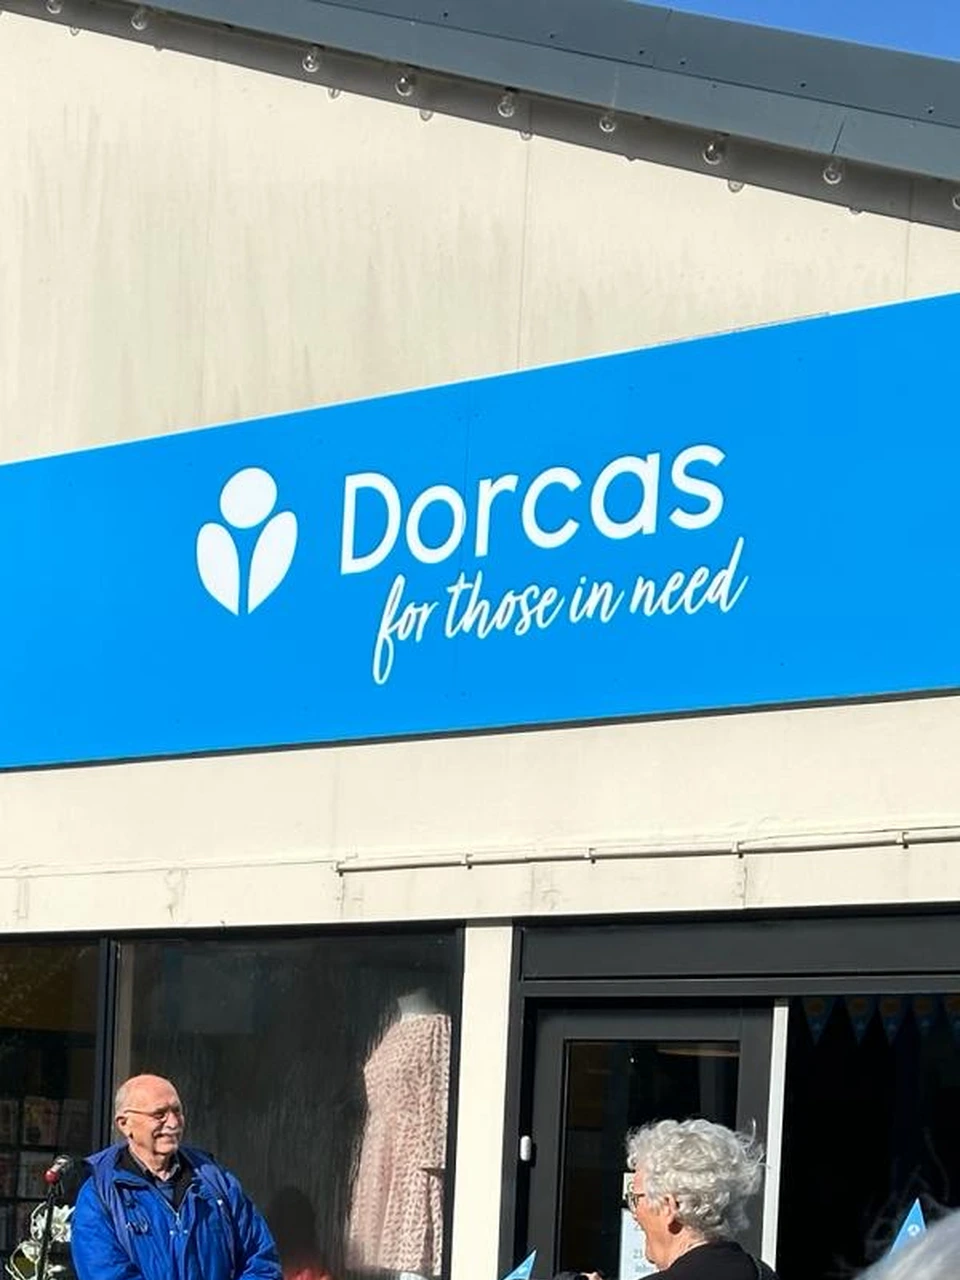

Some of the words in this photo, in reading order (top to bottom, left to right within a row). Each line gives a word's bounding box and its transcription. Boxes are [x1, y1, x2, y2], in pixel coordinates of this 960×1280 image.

[340, 444, 726, 575] Dorcas
[372, 574, 438, 684] for
[445, 571, 564, 639] those
[569, 573, 625, 623] in
[630, 536, 748, 616] need
